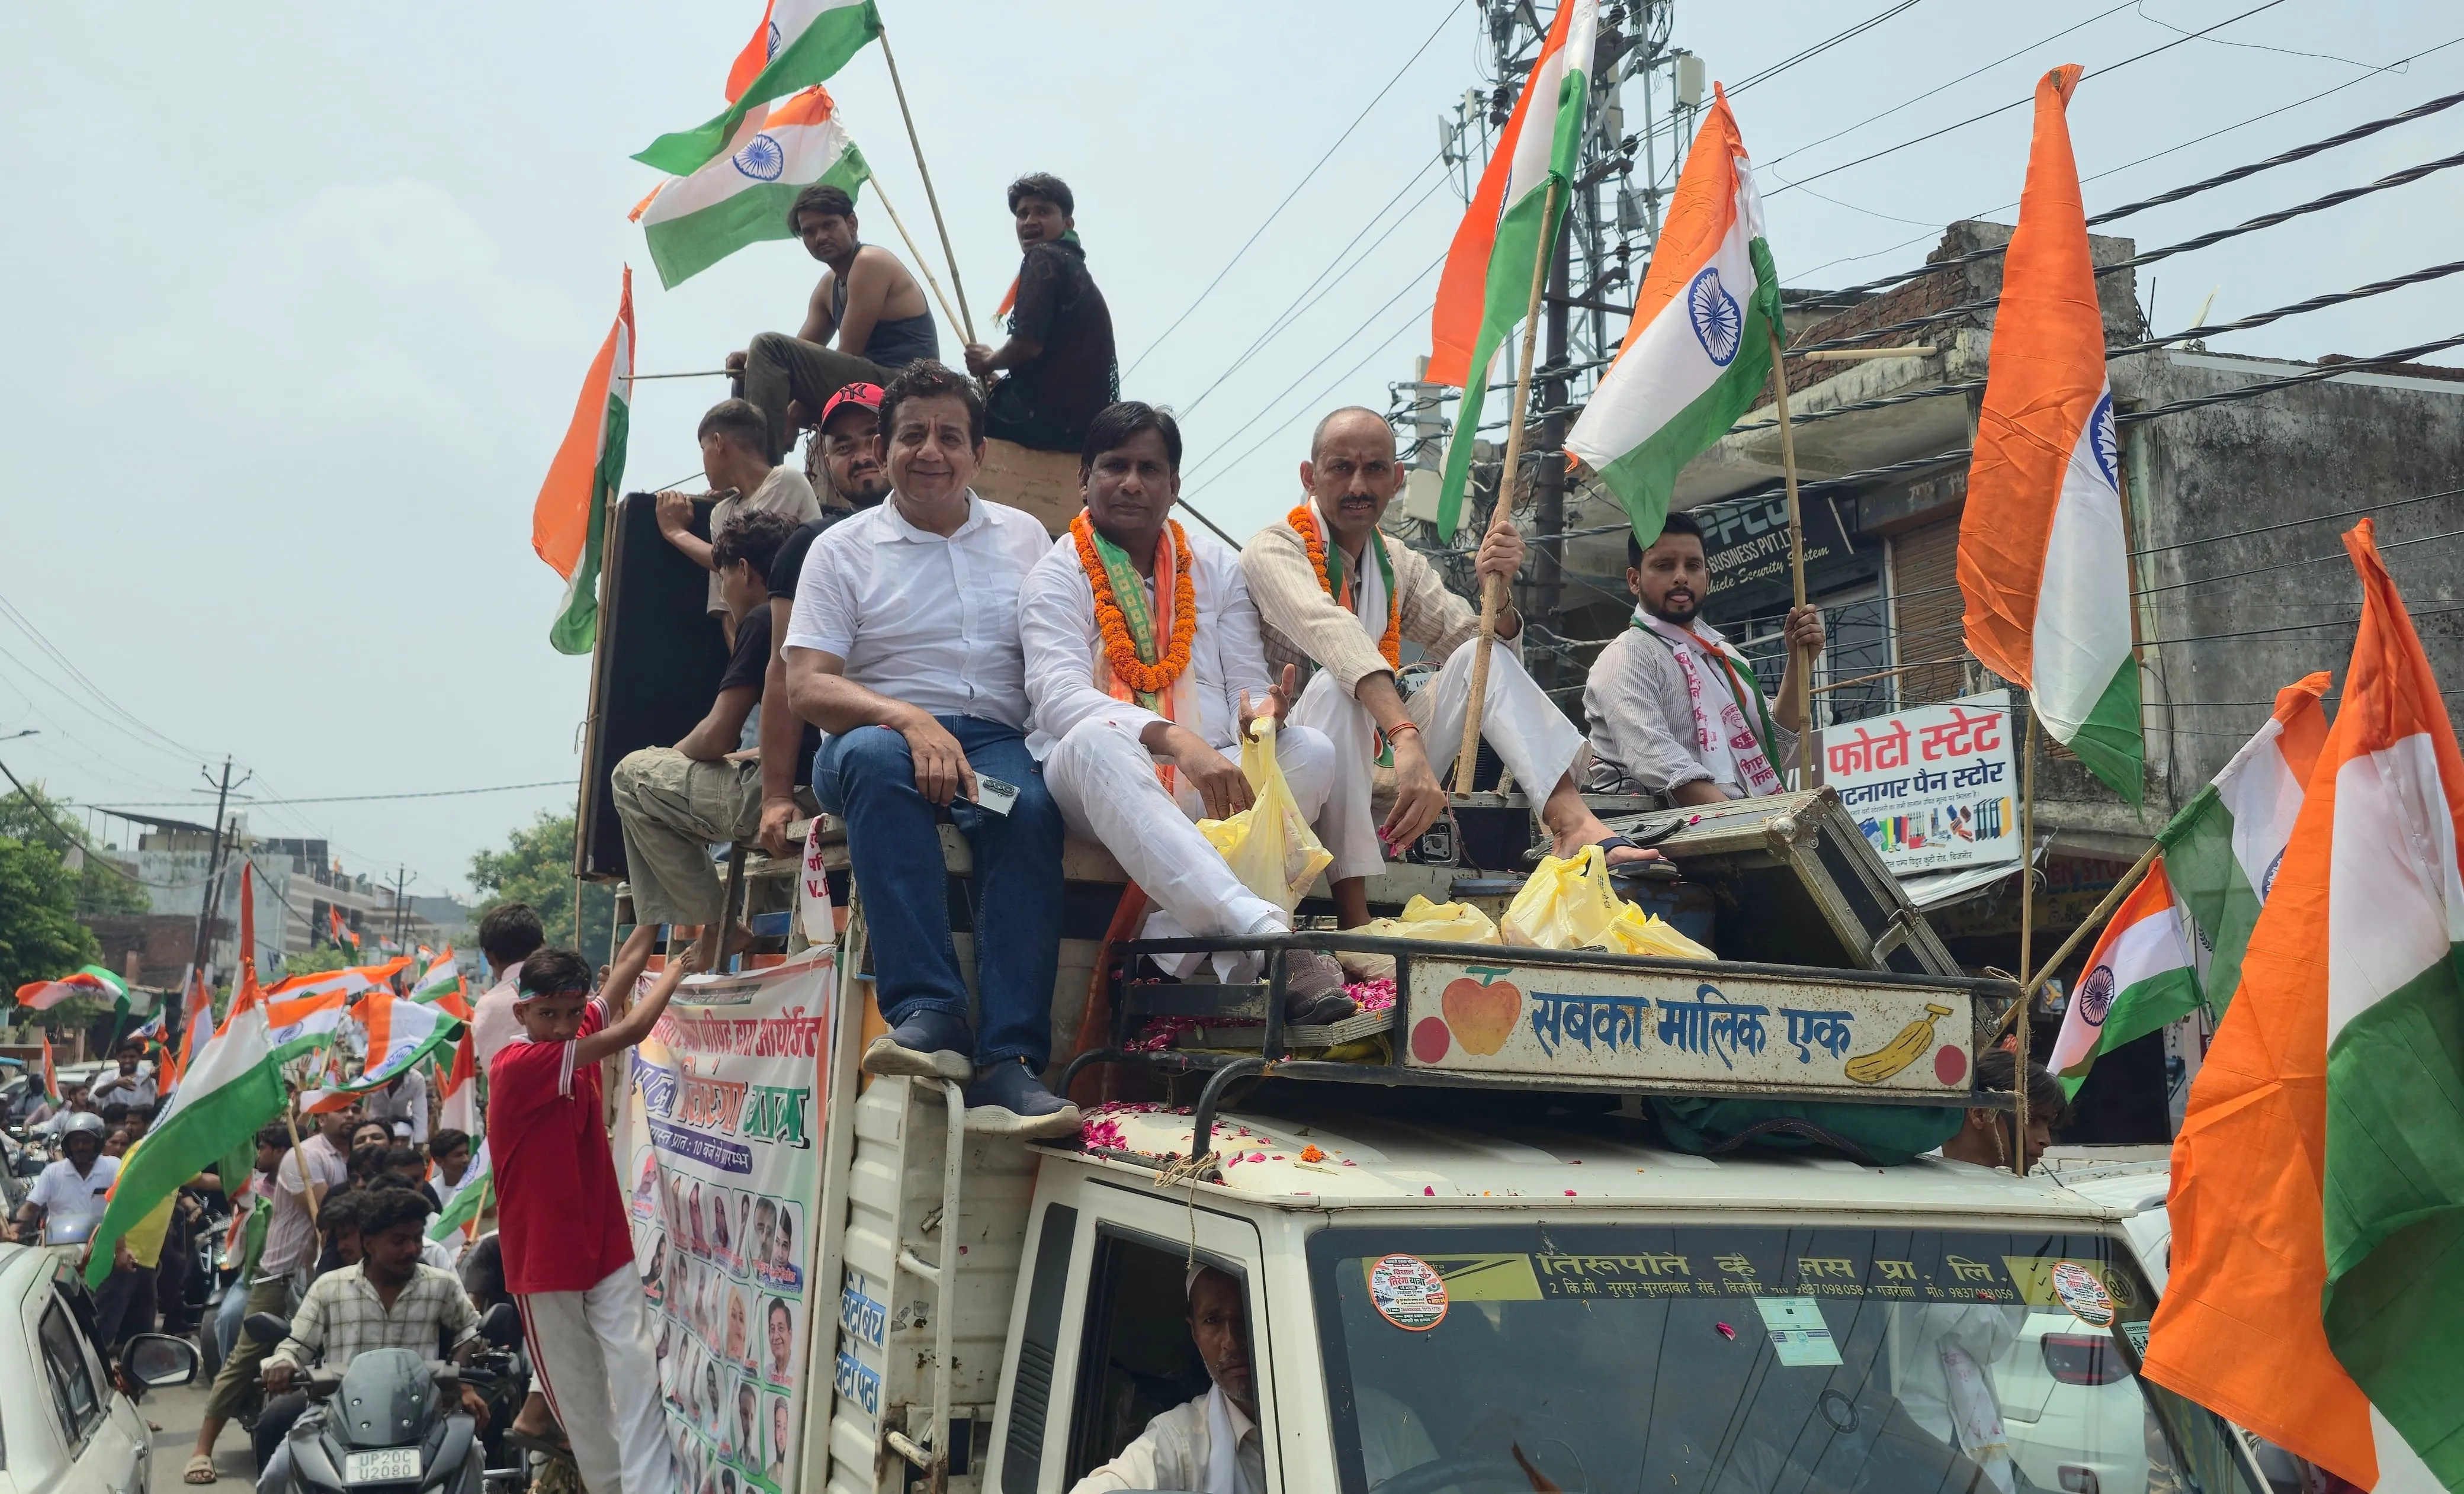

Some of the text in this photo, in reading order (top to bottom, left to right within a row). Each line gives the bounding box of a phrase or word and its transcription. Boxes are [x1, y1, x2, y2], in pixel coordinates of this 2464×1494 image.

[1706, 546, 1830, 596] hicle Security Sstem
[1707, 528, 1807, 574] BUSINESS PVT.LT.
[1827, 707, 2003, 777] फोटो स्टेट
[1913, 767, 1948, 793] पैन
[1952, 758, 2006, 788] स्टोर
[1529, 984, 1855, 1071] सबका मालिक एक
[678, 1055, 748, 1137] तिरंगा
[650, 1125, 673, 1144] गस्त
[693, 1140, 703, 1156] 10
[1388, 1275, 1409, 1286] तिरंगा
[1409, 1277, 1426, 1286] यात्रा
[1549, 1283, 1559, 1294] 2
[1946, 1255, 2008, 1283] लि.
